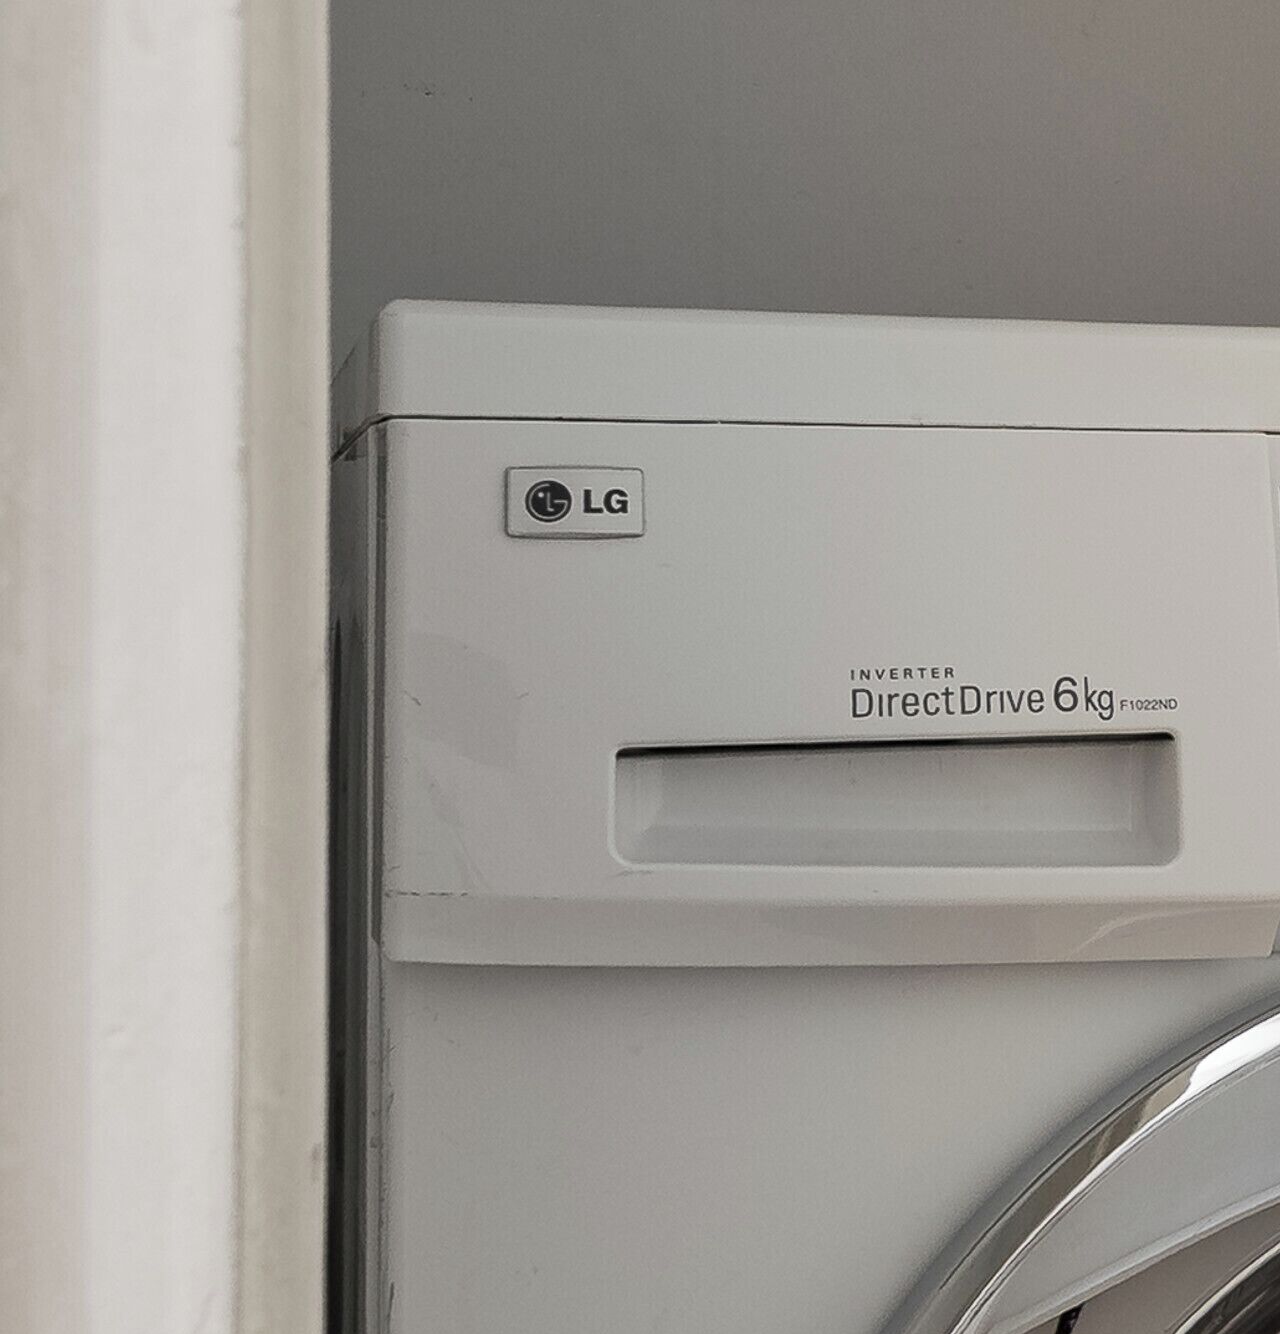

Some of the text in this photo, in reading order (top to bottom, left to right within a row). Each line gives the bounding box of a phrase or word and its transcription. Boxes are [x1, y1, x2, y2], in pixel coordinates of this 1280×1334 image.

[582, 489, 629, 515] LG
[850, 667, 955, 680] INVERTER
[1054, 676, 1115, 721] 6kg
[1120, 698, 1178, 711] F1022ND
